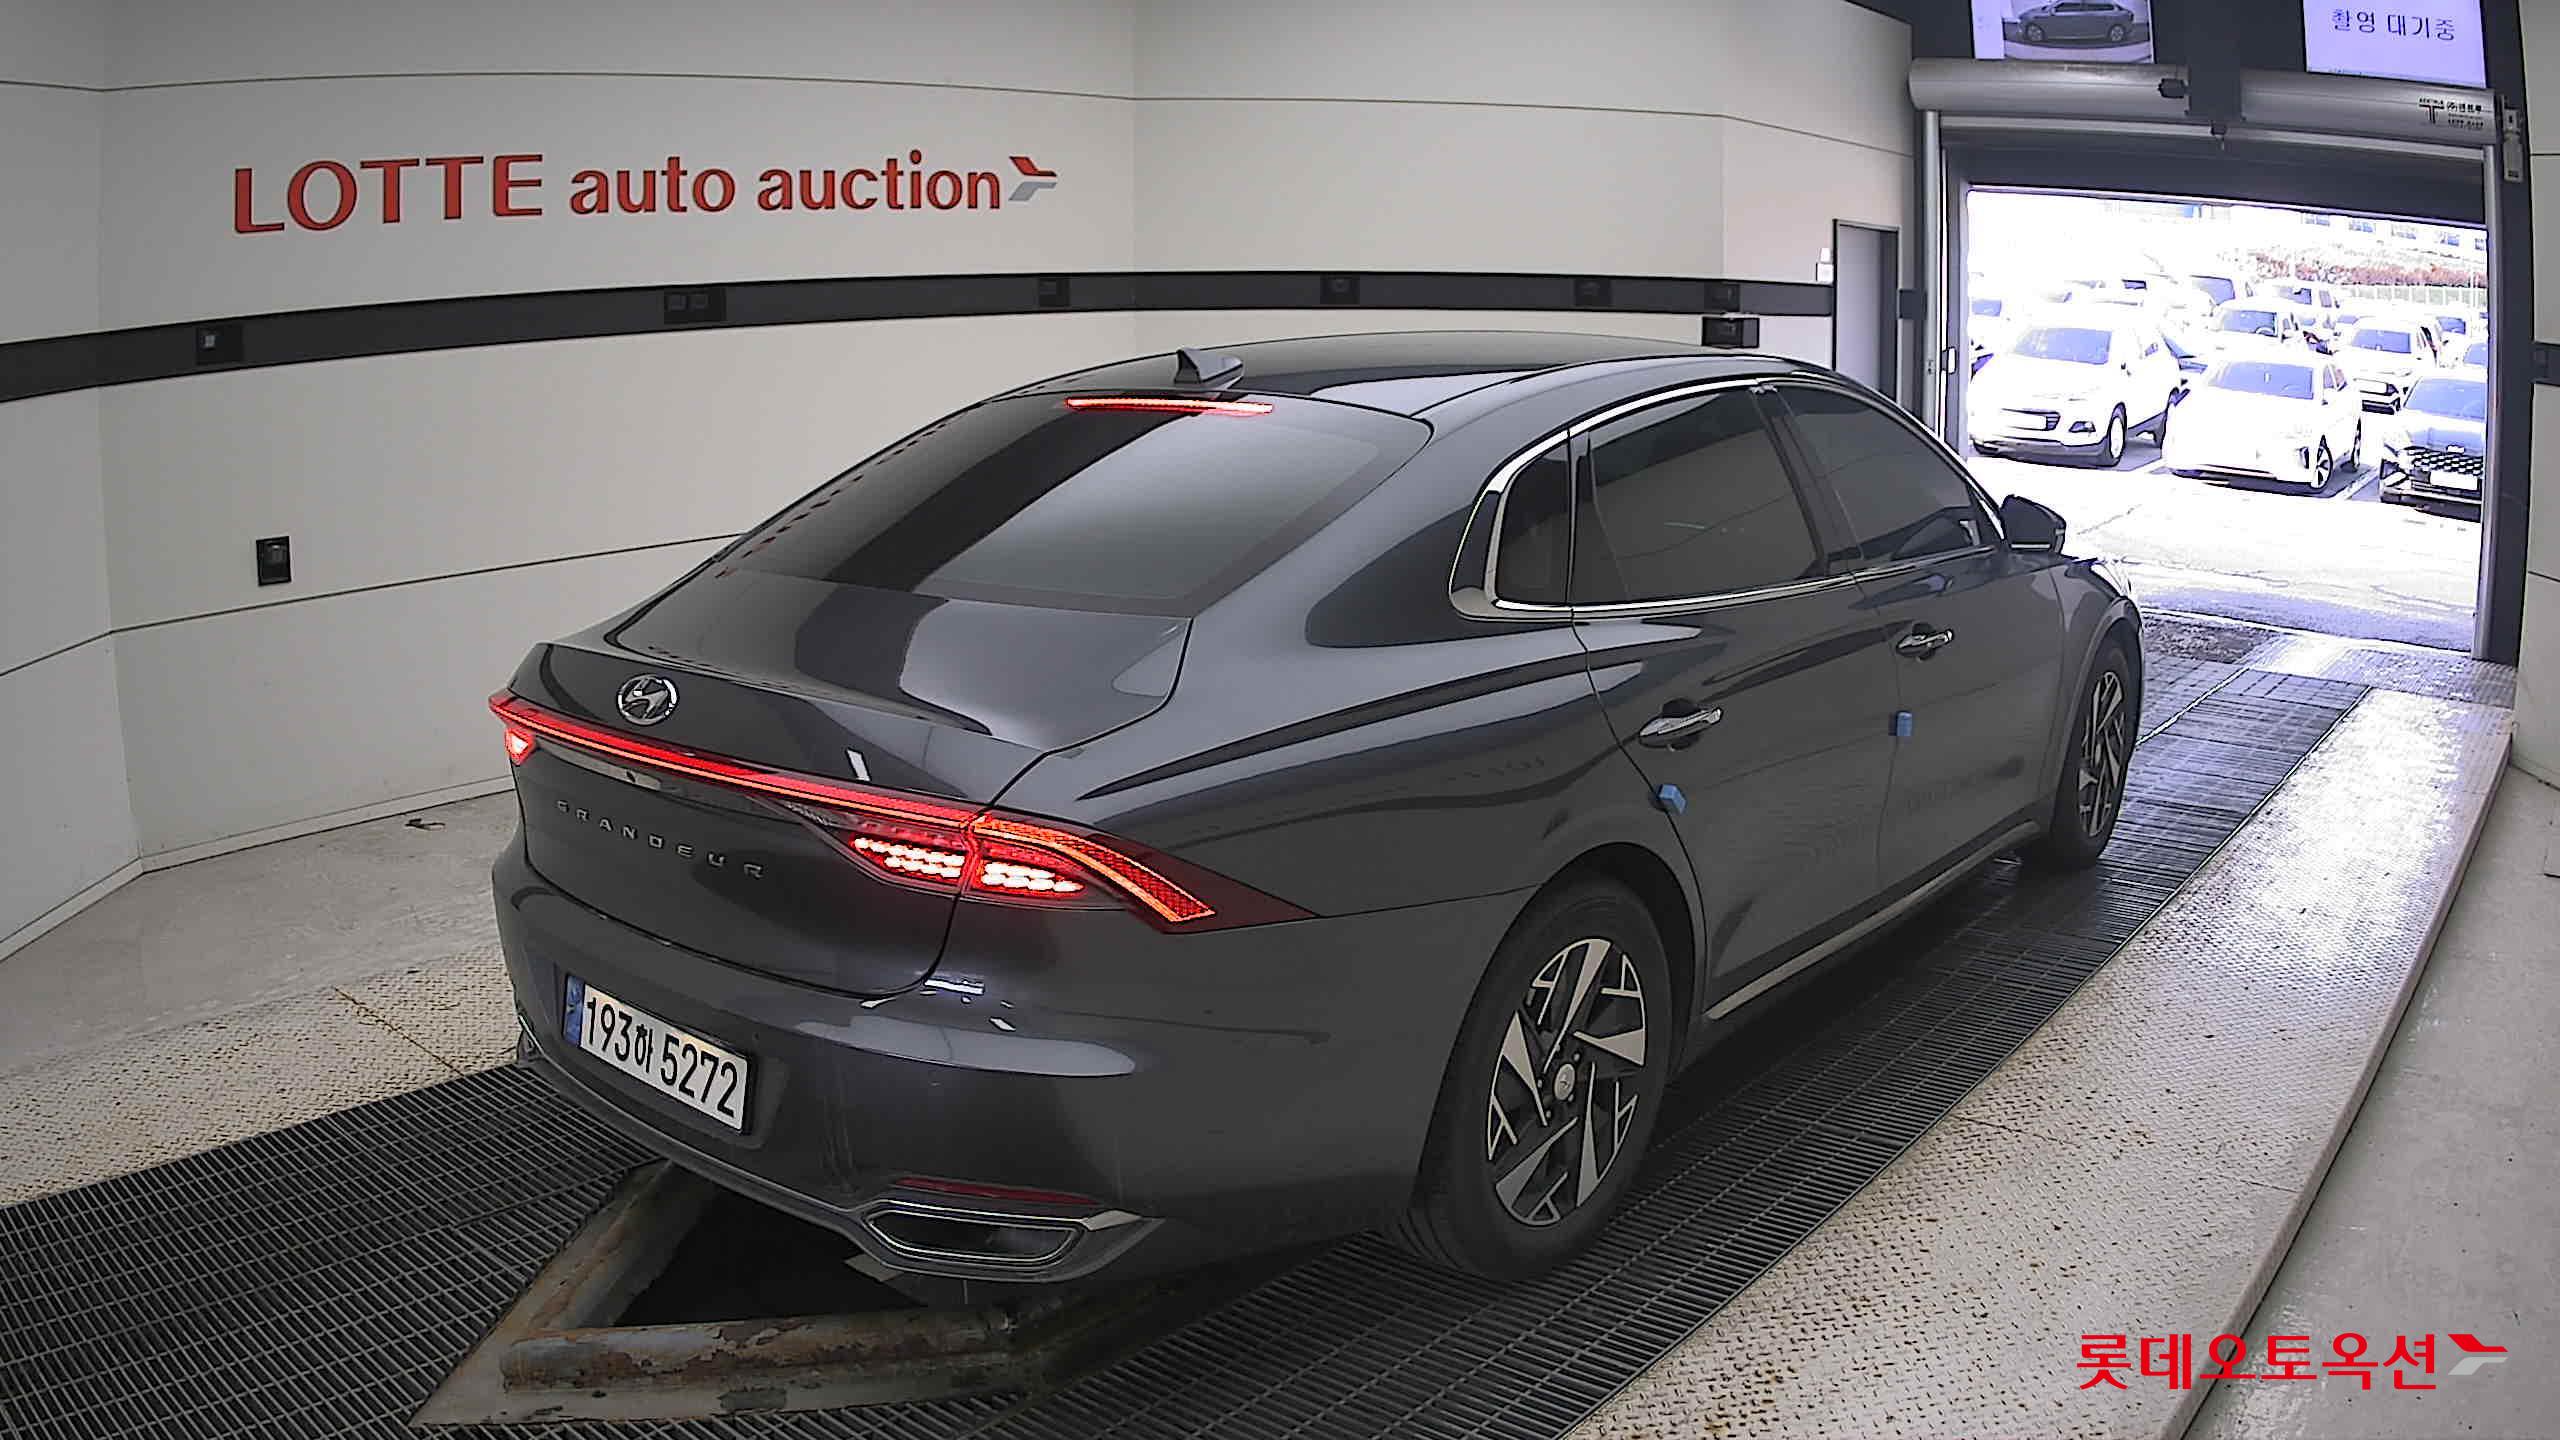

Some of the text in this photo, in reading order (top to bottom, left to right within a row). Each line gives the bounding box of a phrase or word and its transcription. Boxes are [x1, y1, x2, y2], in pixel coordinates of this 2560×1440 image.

[2387, 14, 2456, 41] 대기중
[234, 149, 1001, 234] LOTTE auto auction
[556, 799, 764, 879] GRANDEUR
[660, 1033, 738, 1118] 5272
